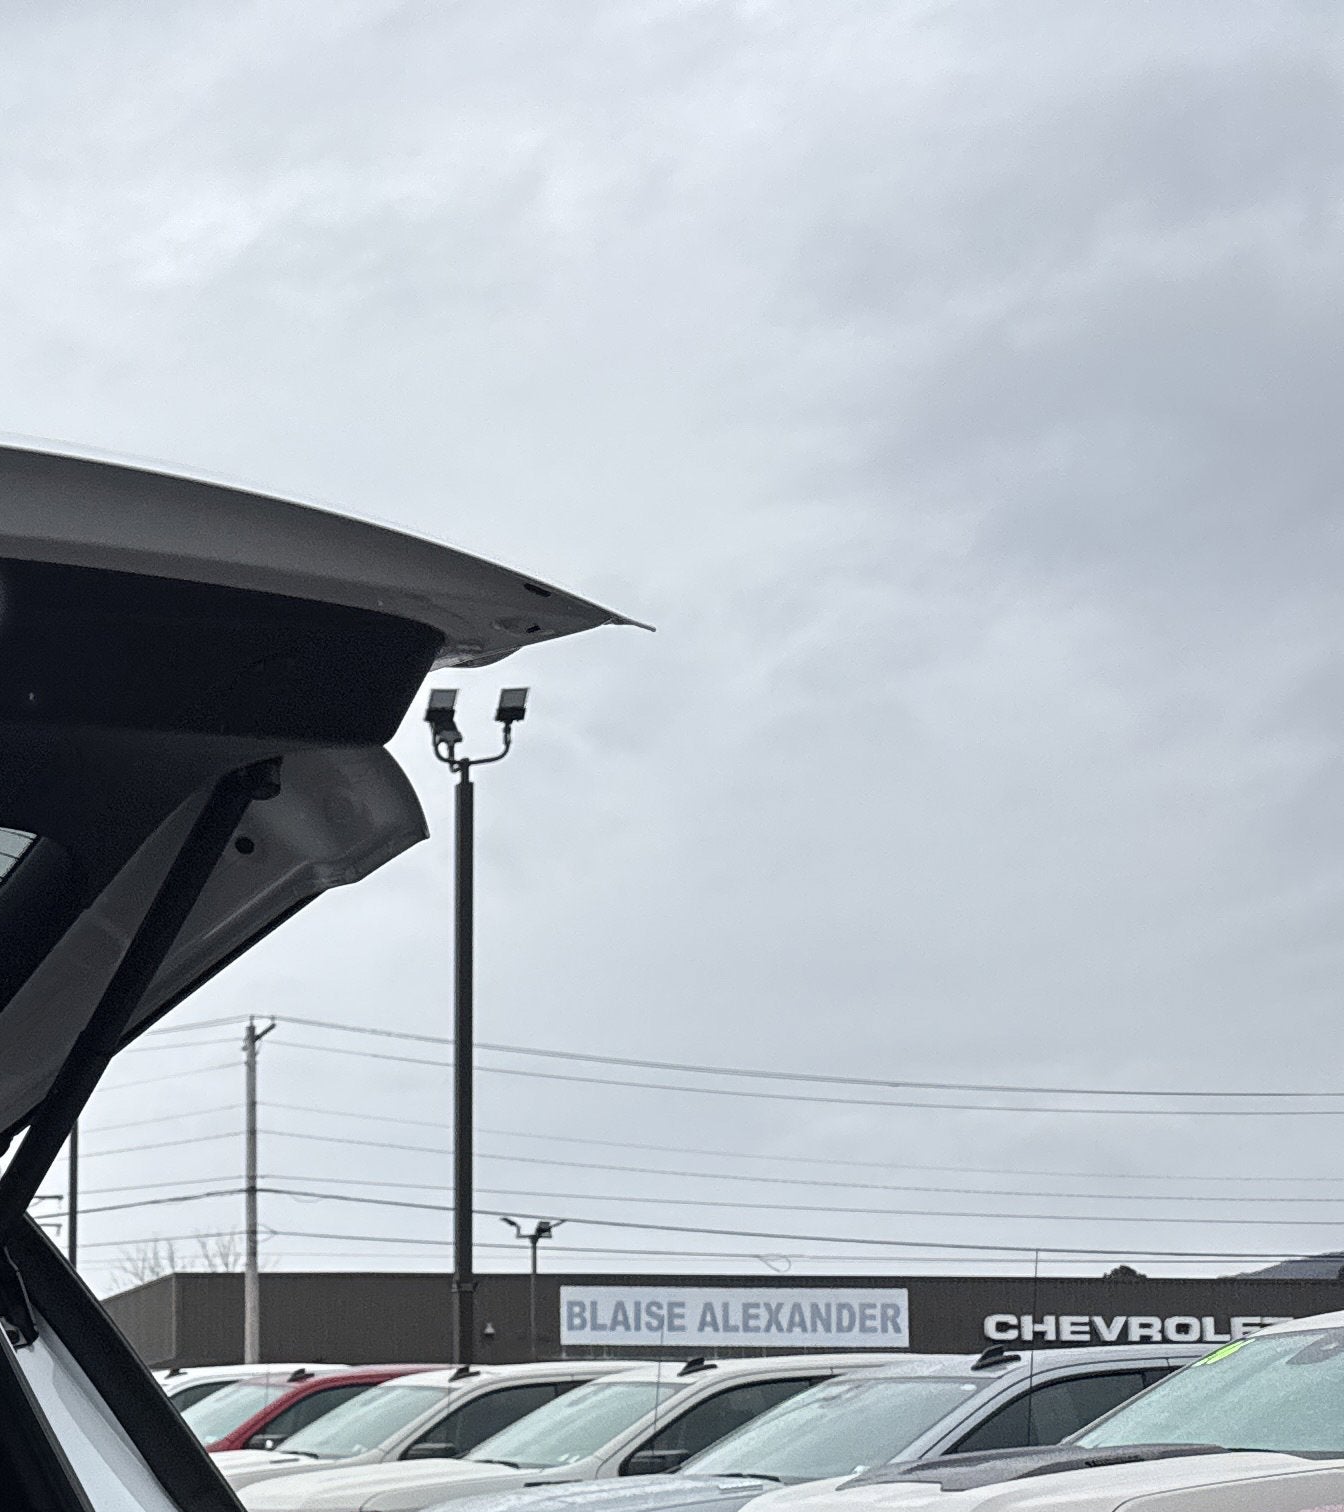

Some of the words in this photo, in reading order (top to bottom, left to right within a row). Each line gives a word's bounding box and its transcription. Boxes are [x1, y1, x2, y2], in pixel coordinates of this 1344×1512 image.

[566, 1300, 687, 1333] BLAISE
[697, 1301, 902, 1335] ALEXANDER
[983, 1313, 1296, 1342] CHEVROLE
